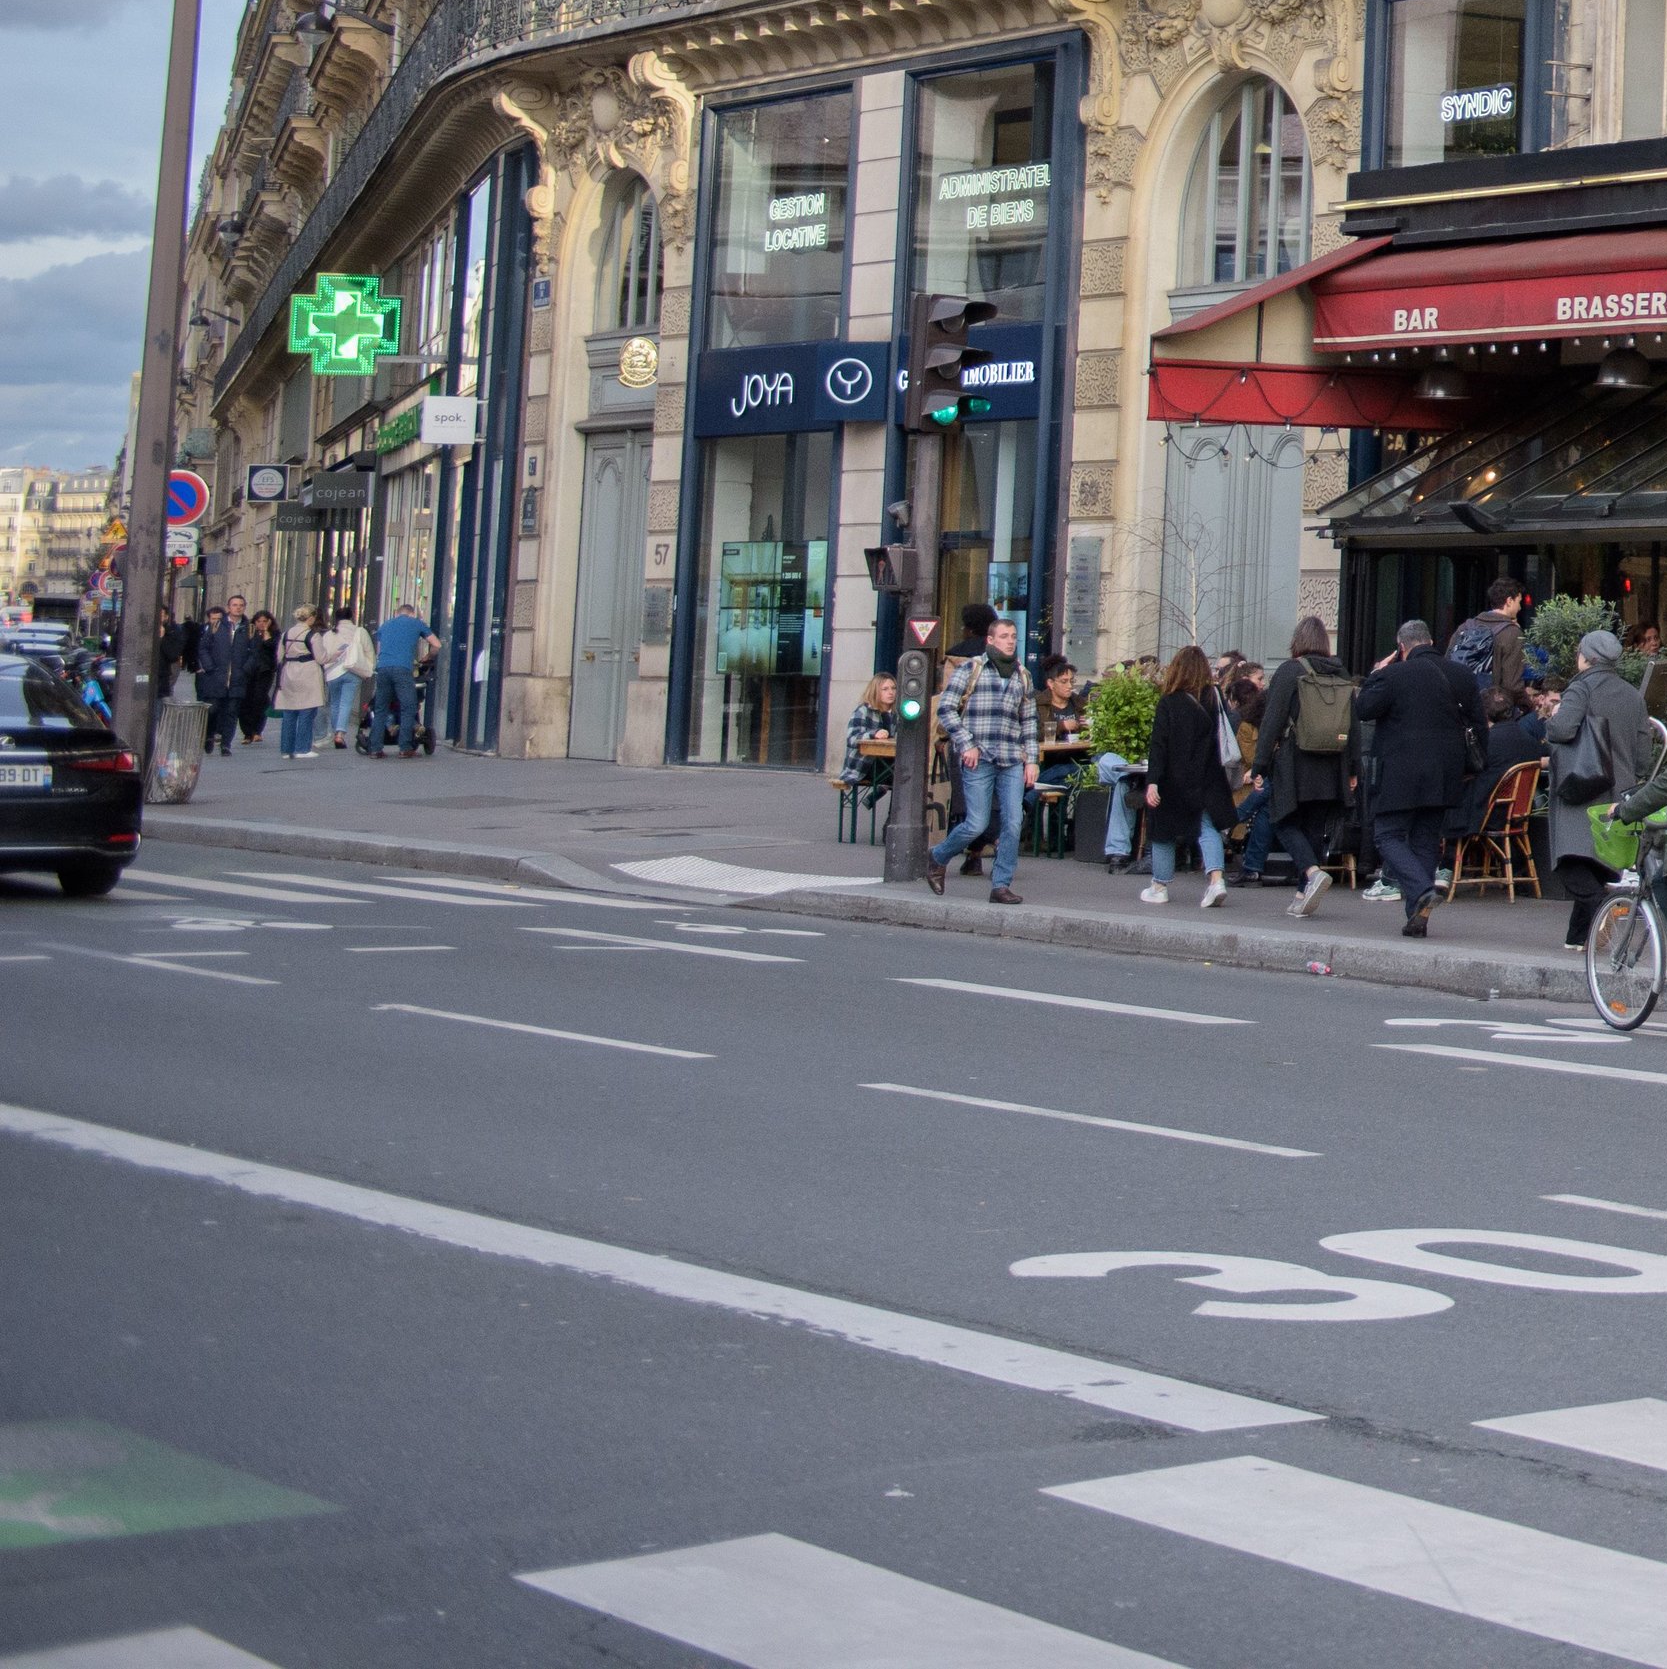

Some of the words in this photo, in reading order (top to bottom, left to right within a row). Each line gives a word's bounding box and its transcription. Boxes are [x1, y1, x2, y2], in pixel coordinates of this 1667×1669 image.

[1441, 87, 1514, 122] SYNDIC
[769, 193, 825, 221] GESTION
[967, 205, 988, 229] DE
[990, 199, 1035, 227] BIENS
[765, 223, 826, 251] LOCATIVE
[1394, 307, 1439, 332] BAR
[732, 372, 794, 418] JOYA
[434, 412, 466, 424] spok.
[316, 488, 366, 500] cojean
[655, 543, 670, 565] 57
